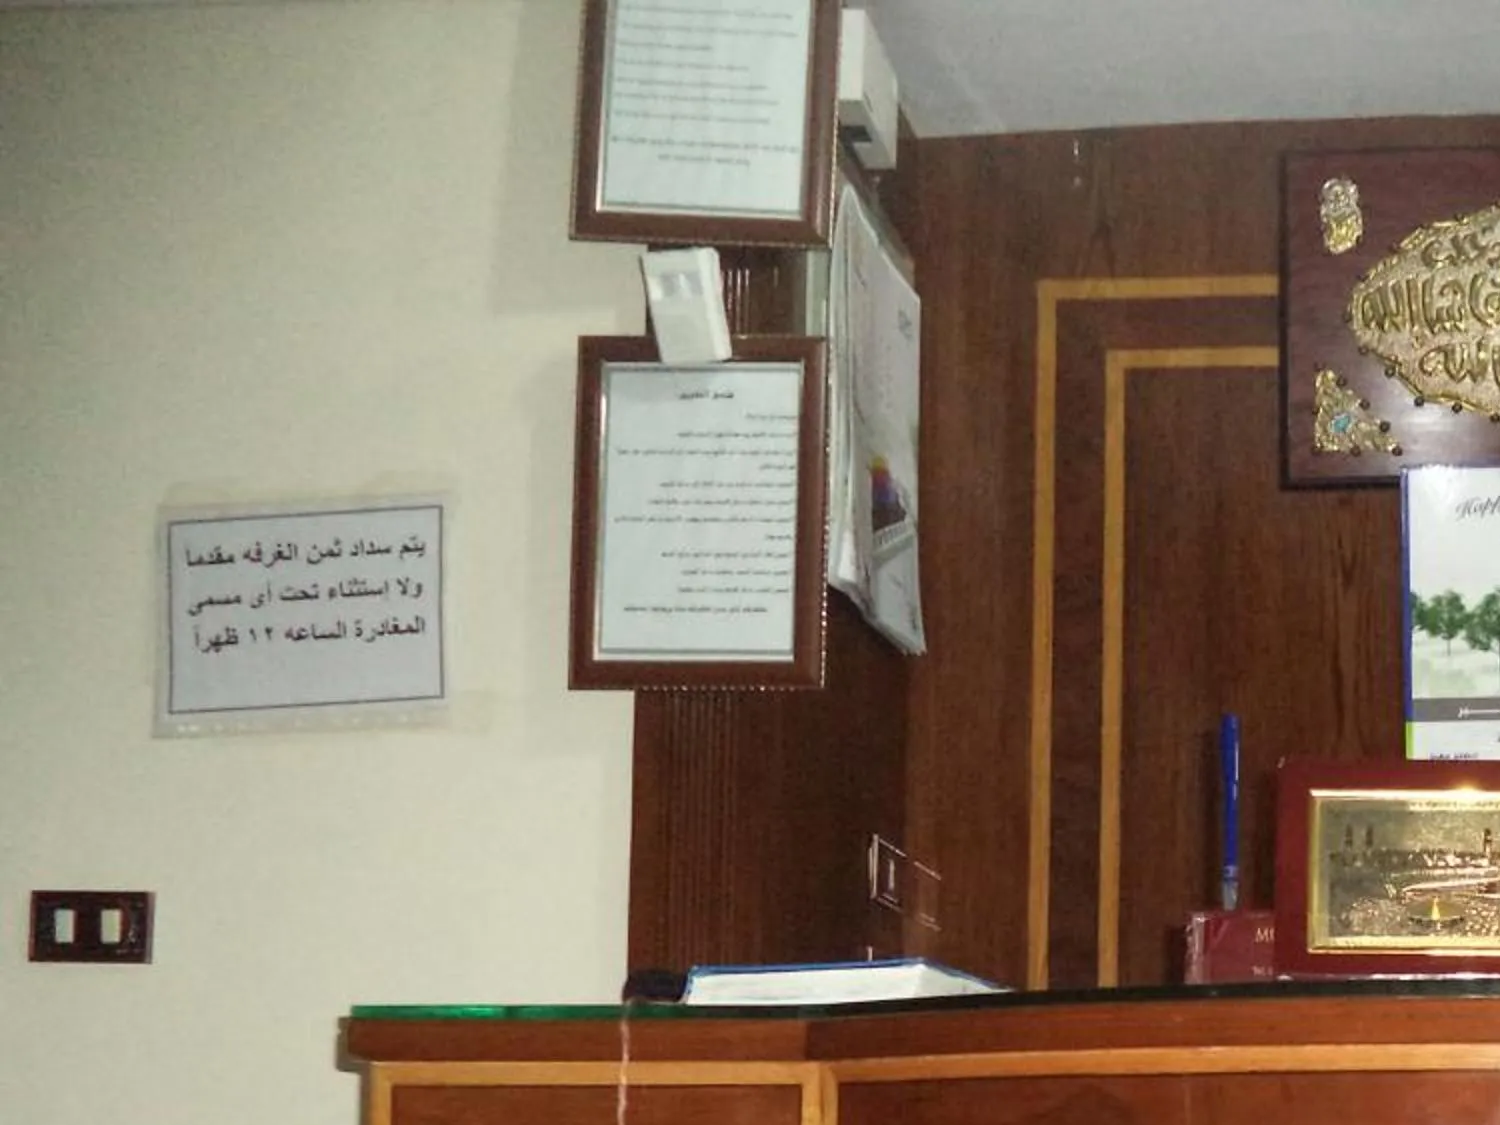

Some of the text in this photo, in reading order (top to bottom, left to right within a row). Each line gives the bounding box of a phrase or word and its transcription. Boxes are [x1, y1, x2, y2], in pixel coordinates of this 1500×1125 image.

[306, 537, 343, 566] ثمن
[350, 538, 392, 559] سداد
[399, 535, 427, 561] يتم
[279, 582, 321, 603] تحت
[396, 576, 424, 599] ولا
[354, 614, 427, 643] المغادرة
